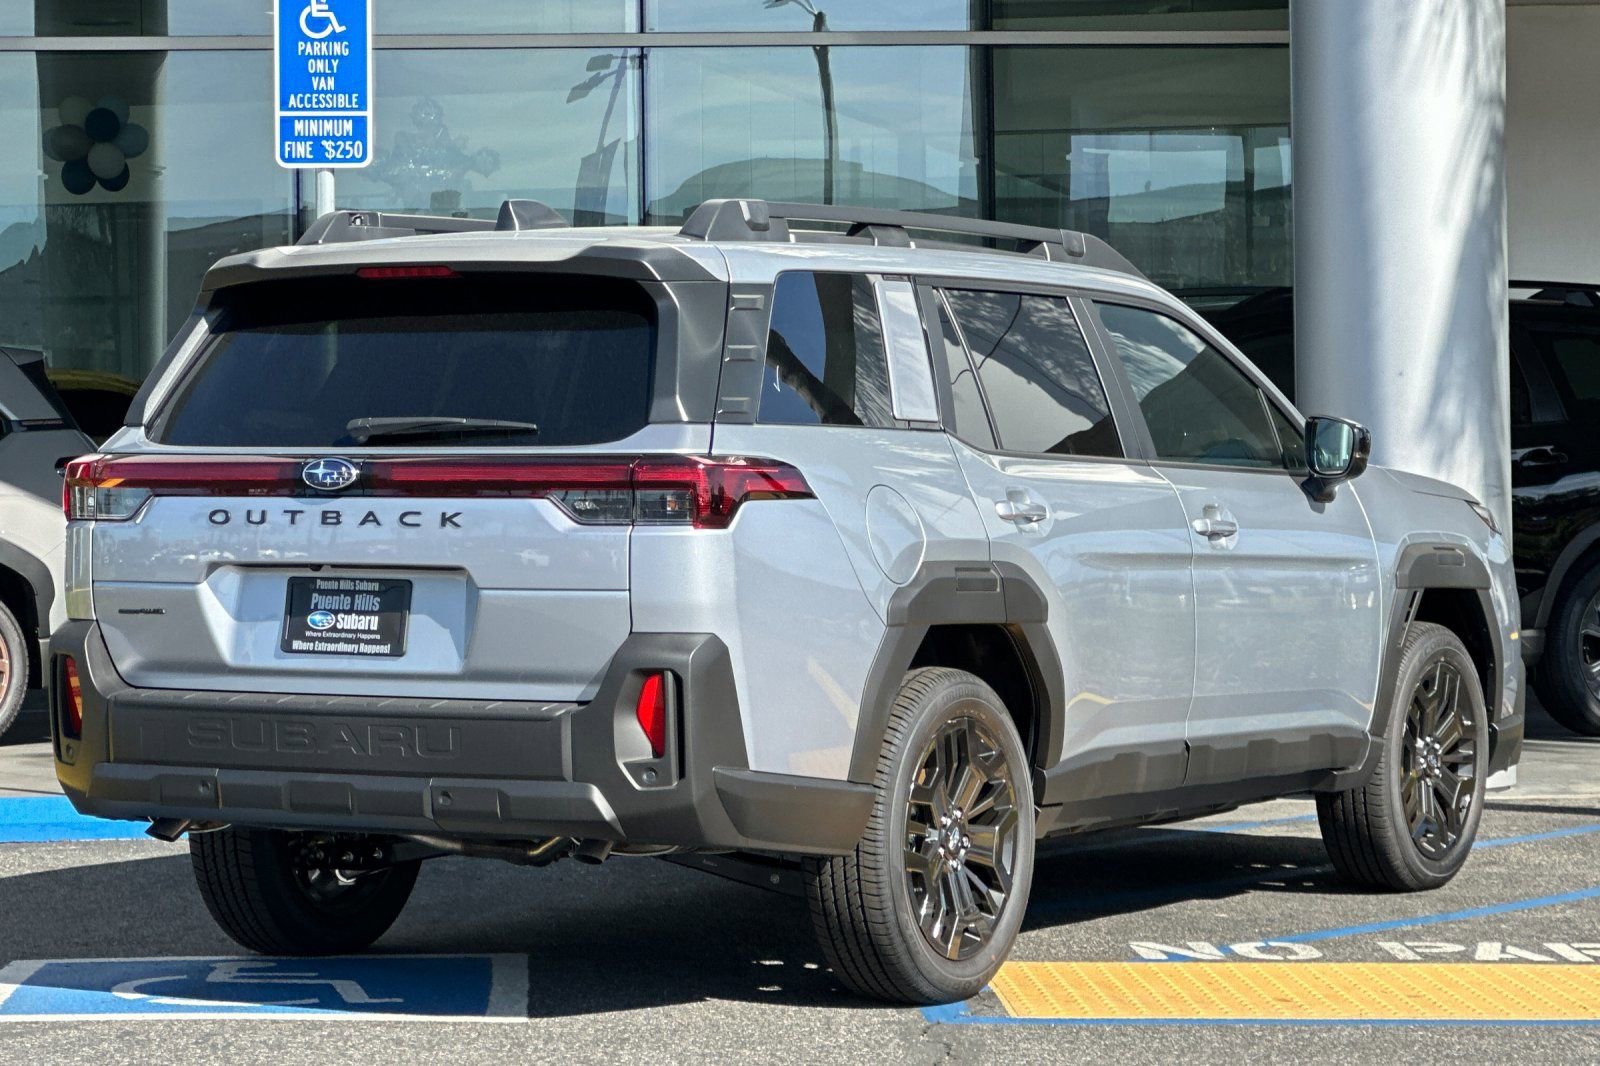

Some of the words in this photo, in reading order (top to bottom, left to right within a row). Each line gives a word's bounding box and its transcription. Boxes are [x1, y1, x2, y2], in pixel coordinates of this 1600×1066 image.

[298, 42, 350, 56] PARKING
[308, 59, 340, 74] ONLY
[312, 76, 335, 90] VAN
[288, 94, 359, 108] ACCESSIBLE
[294, 120, 353, 136] MINIMUM
[284, 141, 314, 158] FINE
[323, 140, 363, 160] $250
[208, 508, 463, 528] OUTBACK
[316, 579, 339, 591] Puente
[340, 580, 354, 591] Hills
[356, 581, 380, 592] Subaru
[310, 592, 352, 610] Puente
[354, 593, 380, 612] Hills
[336, 613, 378, 630] Subaru
[322, 631, 356, 640] Extraordinary
[357, 632, 380, 640] Happens
[292, 640, 314, 651] Where
[314, 640, 358, 653] Extraordinary
[359, 642, 390, 654] Happens!
[188, 717, 462, 758] SUBARU
[1129, 941, 1324, 960] NO
